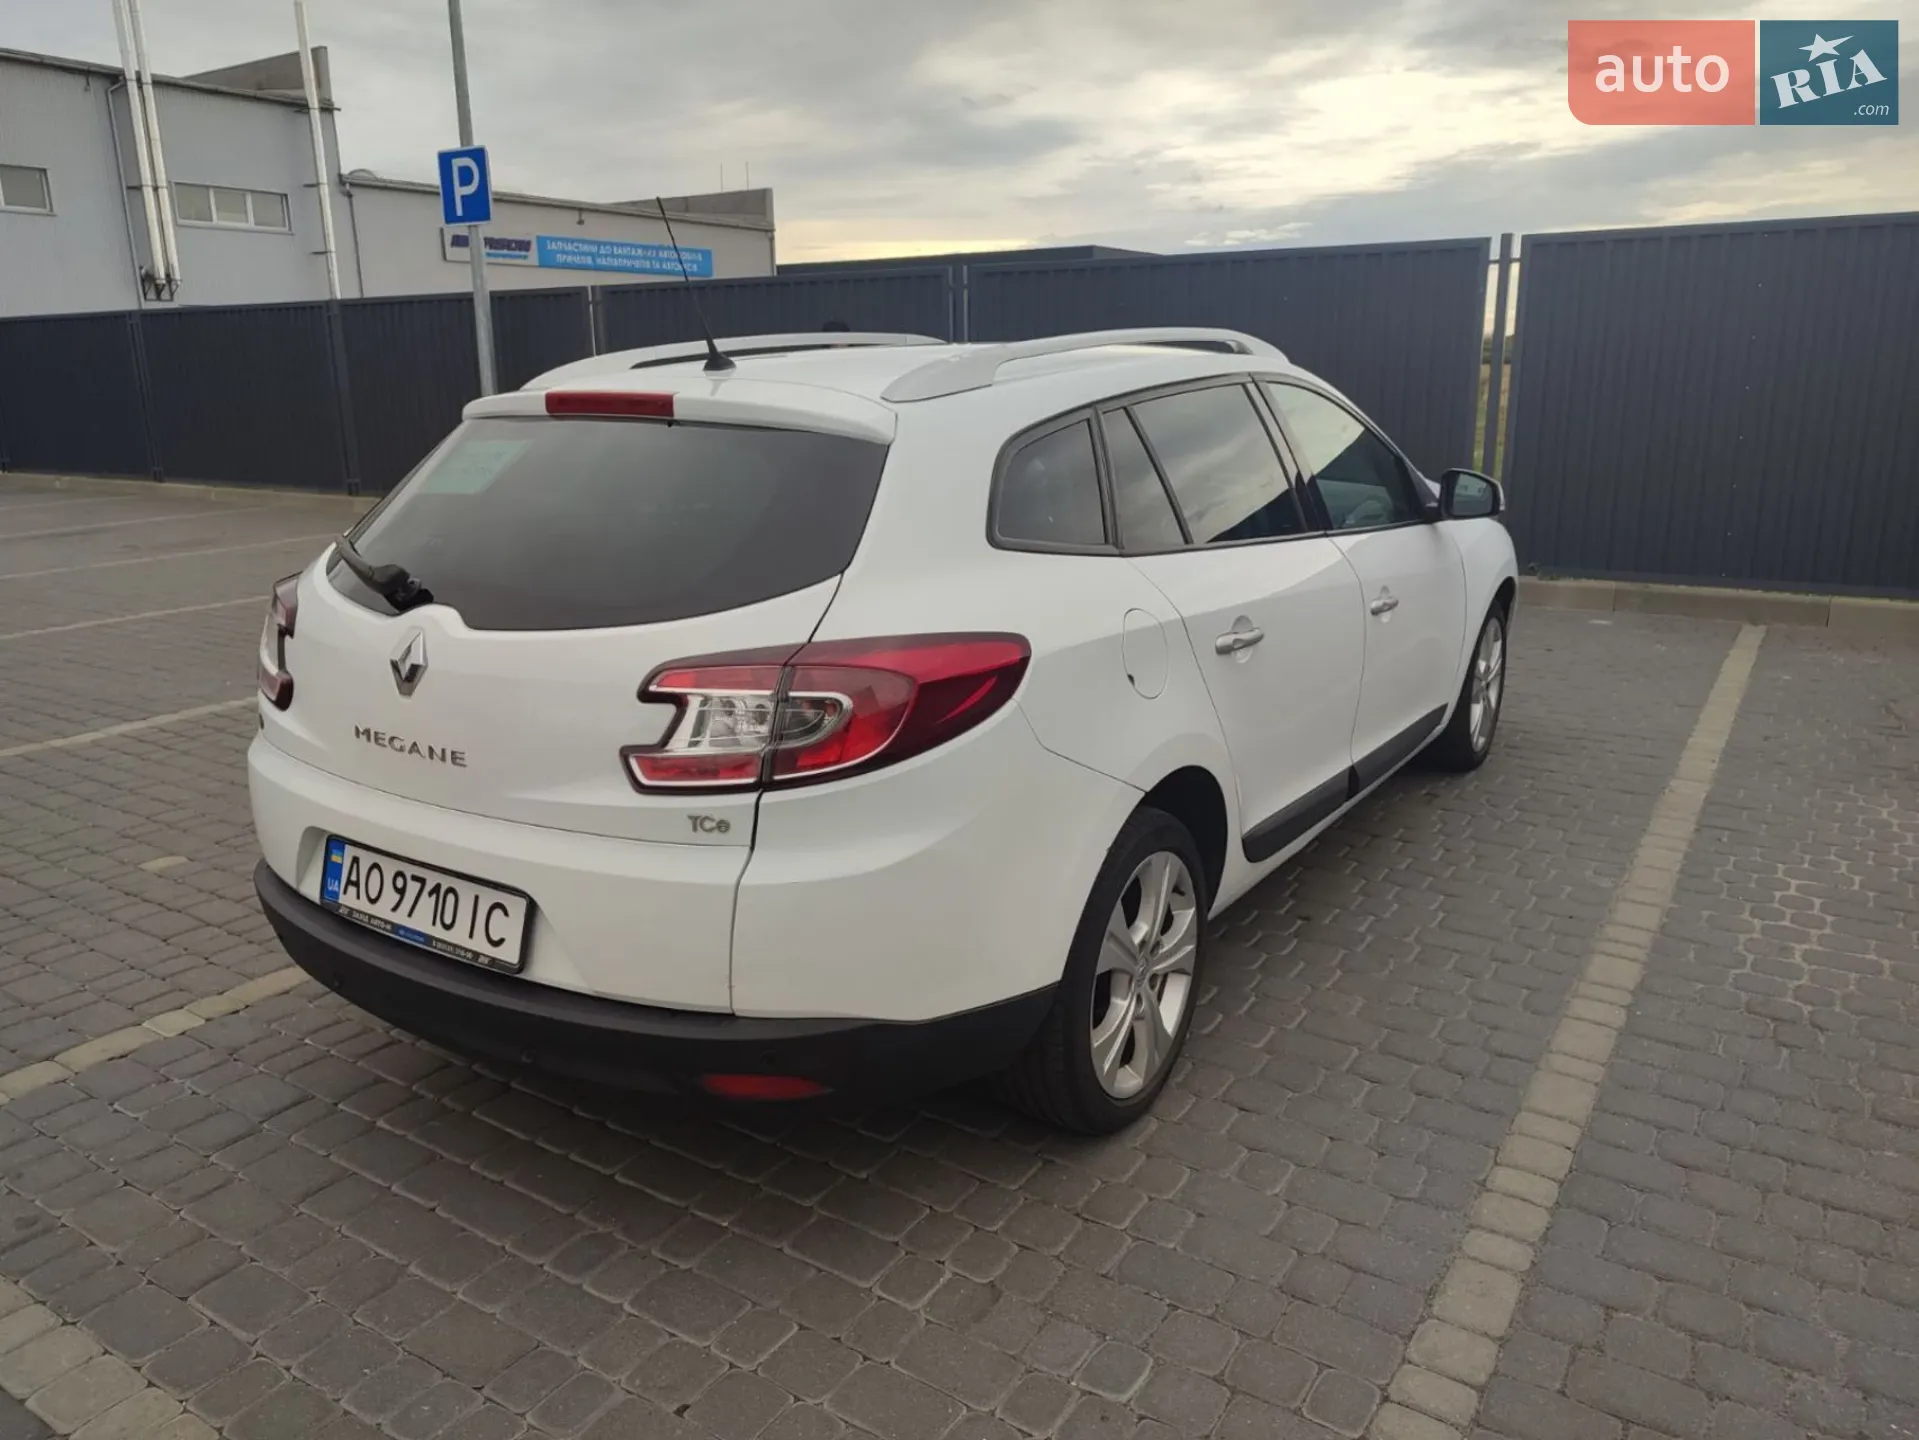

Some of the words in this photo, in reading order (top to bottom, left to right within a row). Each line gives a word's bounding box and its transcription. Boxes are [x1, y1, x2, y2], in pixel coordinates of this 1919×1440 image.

[451, 157, 480, 217] P
[354, 723, 468, 768] MEGANE
[687, 814, 731, 834] TCe
[327, 877, 339, 892] UA
[343, 855, 384, 905] AO
[390, 870, 460, 931] 9710
[468, 894, 510, 948] IC
